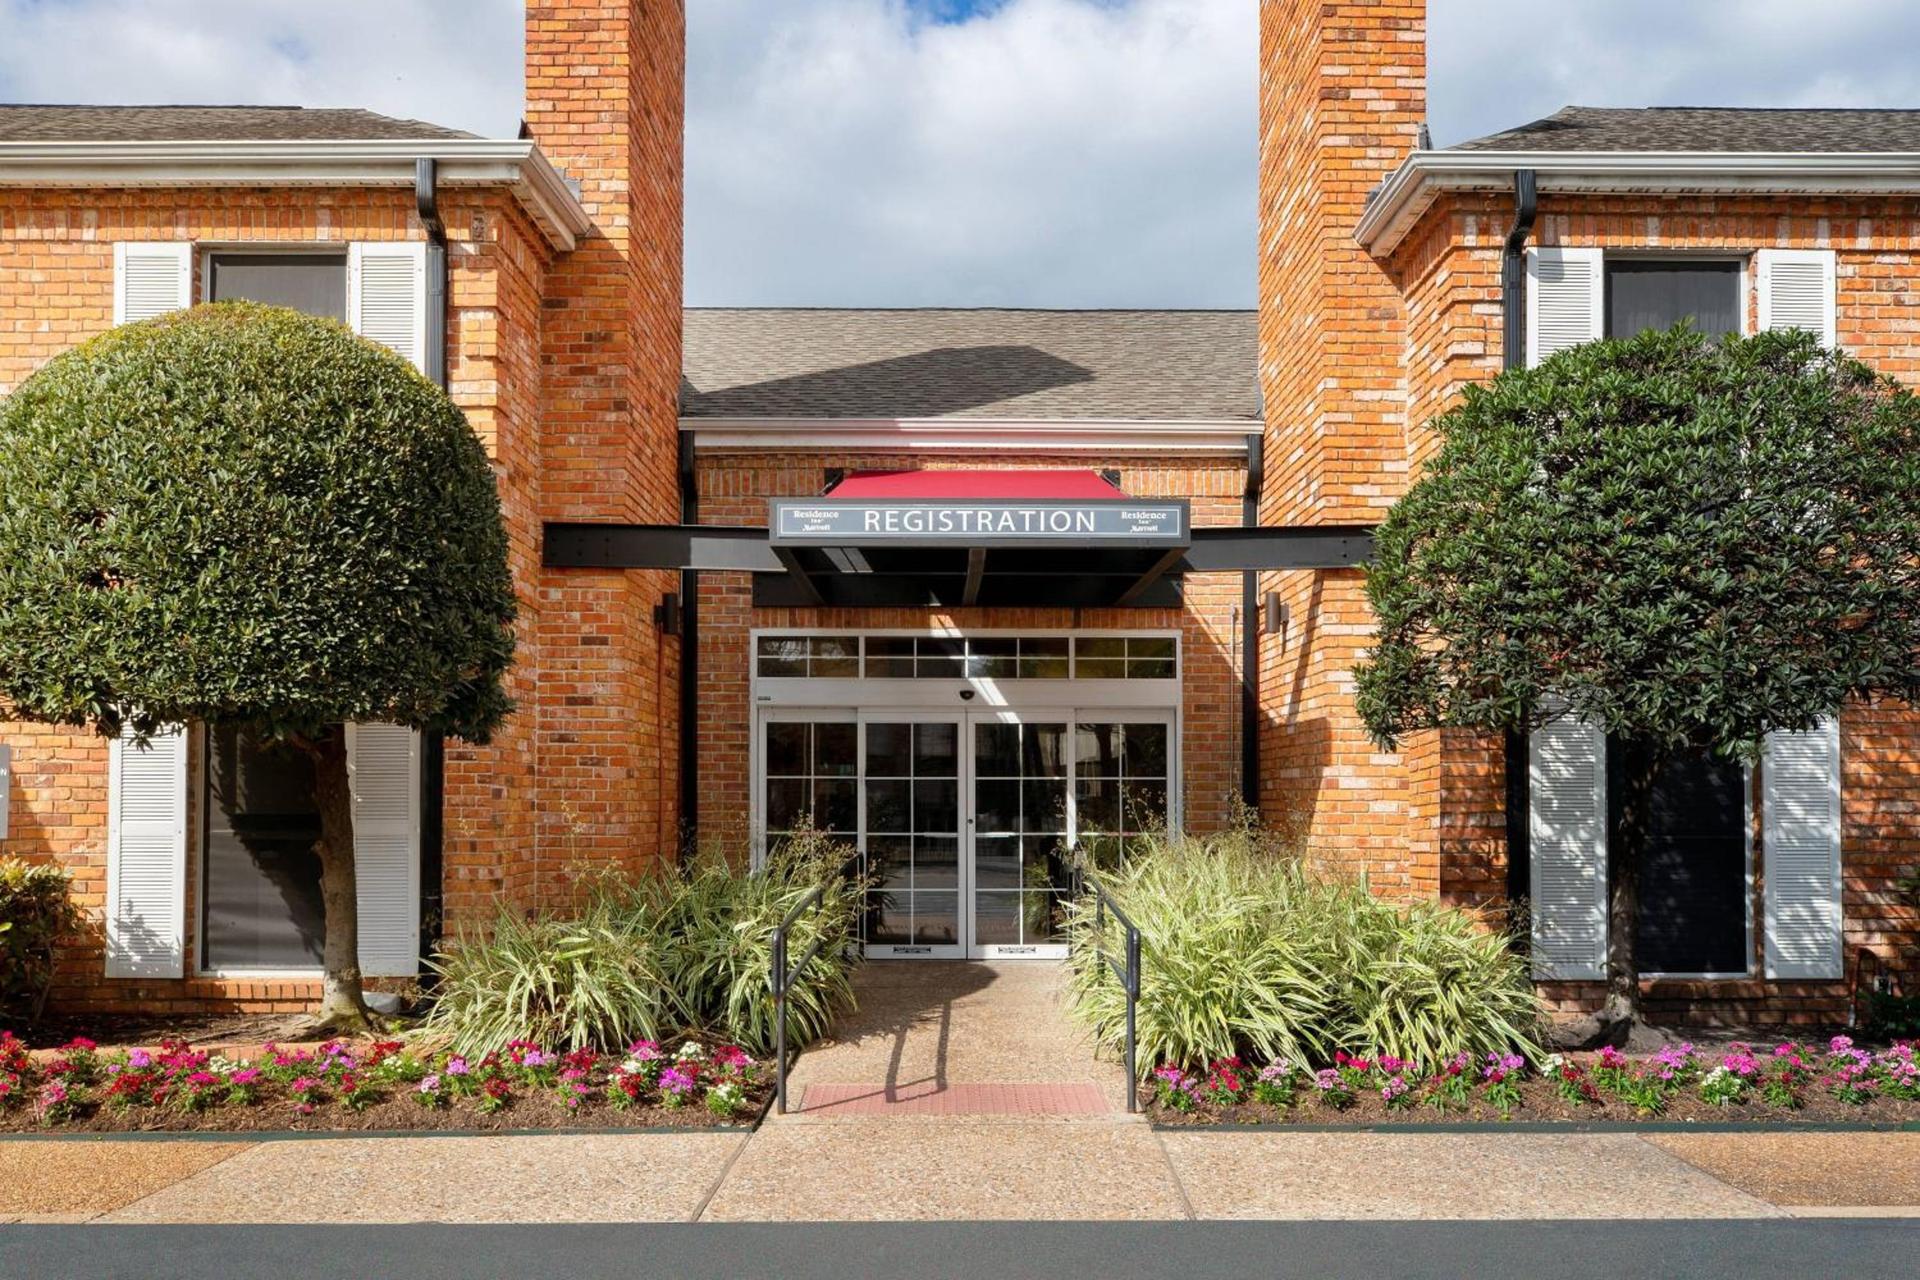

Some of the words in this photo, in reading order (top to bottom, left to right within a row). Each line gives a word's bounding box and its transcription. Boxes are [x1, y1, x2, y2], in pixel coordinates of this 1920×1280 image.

[793, 510, 840, 519] Residence
[1121, 511, 1167, 520] Residence
[863, 510, 1095, 532] REGISTRATION
